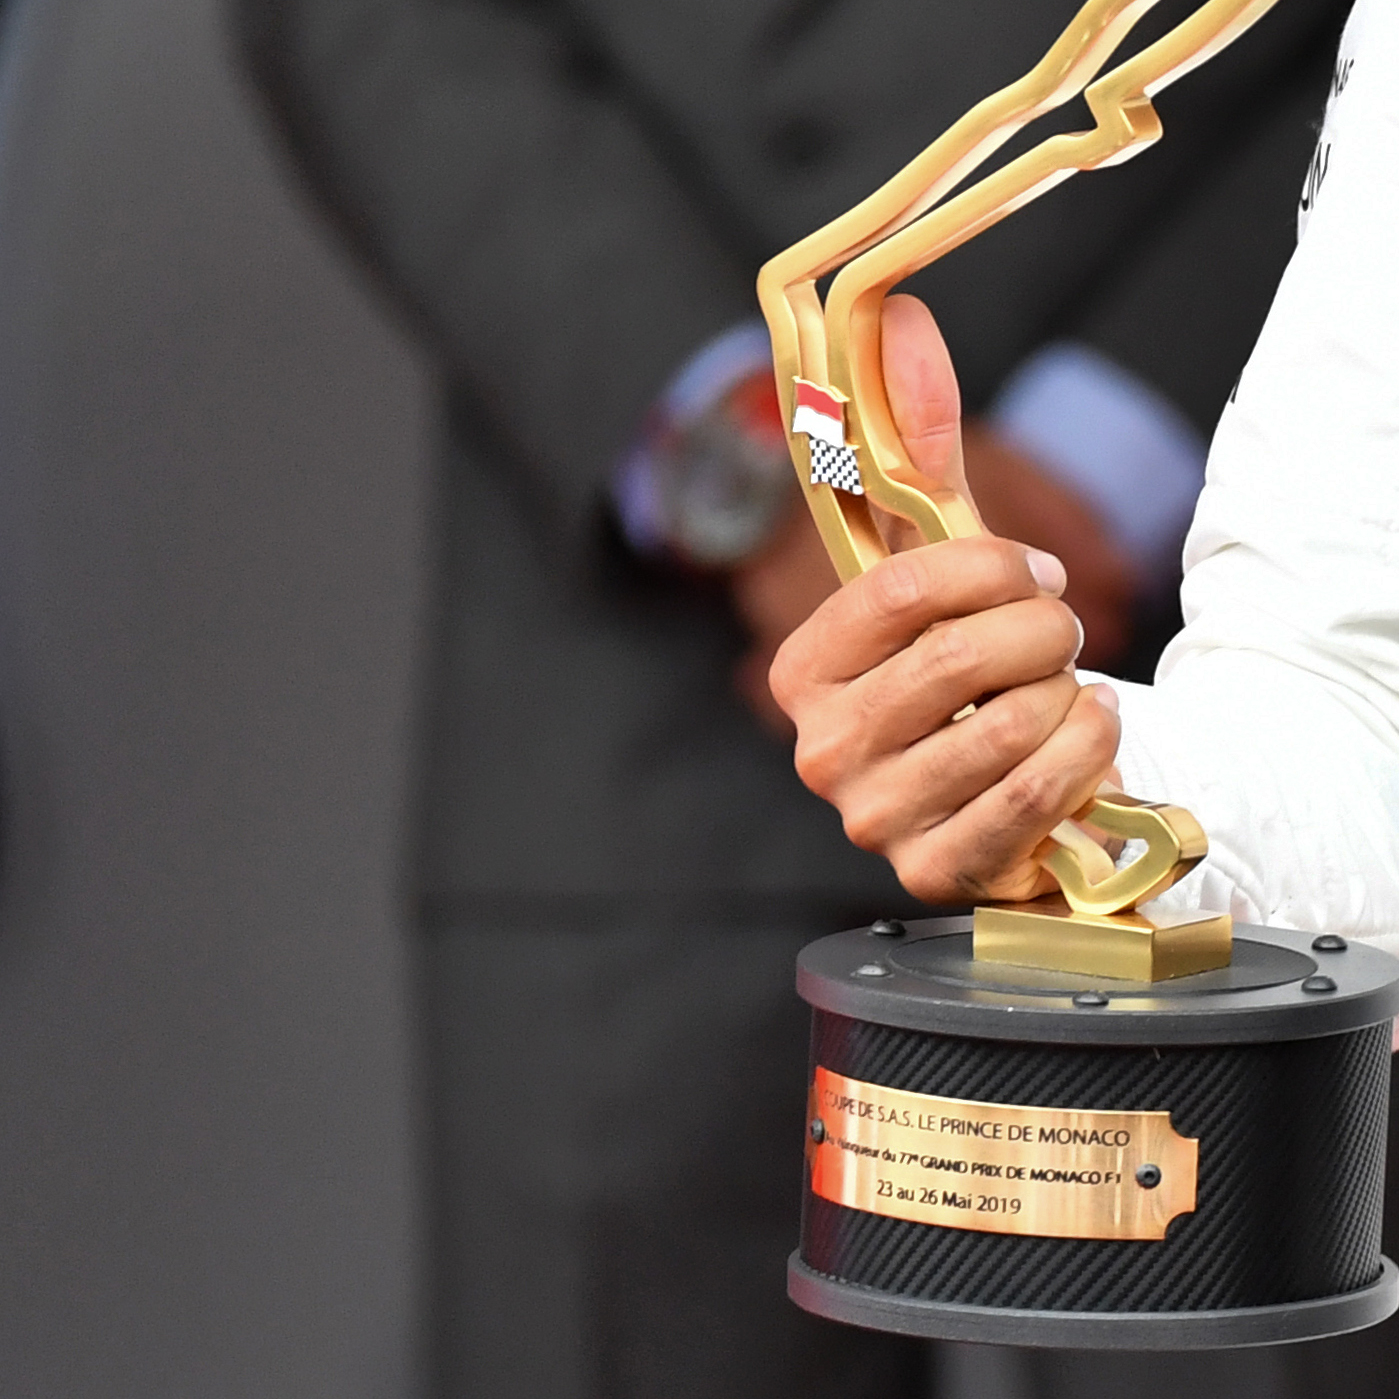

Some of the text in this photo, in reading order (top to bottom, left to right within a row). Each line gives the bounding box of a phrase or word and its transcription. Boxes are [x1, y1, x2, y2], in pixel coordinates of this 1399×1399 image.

[858, 1101, 874, 1120] DE
[877, 1105, 915, 1128] S.A.S.
[918, 1113, 937, 1132] LE
[940, 1116, 1003, 1140] PRINCE
[1007, 1124, 1034, 1143] DE
[1038, 1127, 1131, 1147] MONACO
[920, 1155, 969, 1174] GRAND
[970, 1162, 1002, 1179] PRIX
[1006, 1165, 1026, 1181] DE
[1029, 1168, 1102, 1186] MONACO
[1104, 1171, 1121, 1185] F1
[877, 1179, 1022, 1215] 23 au 26 Mai 2019
